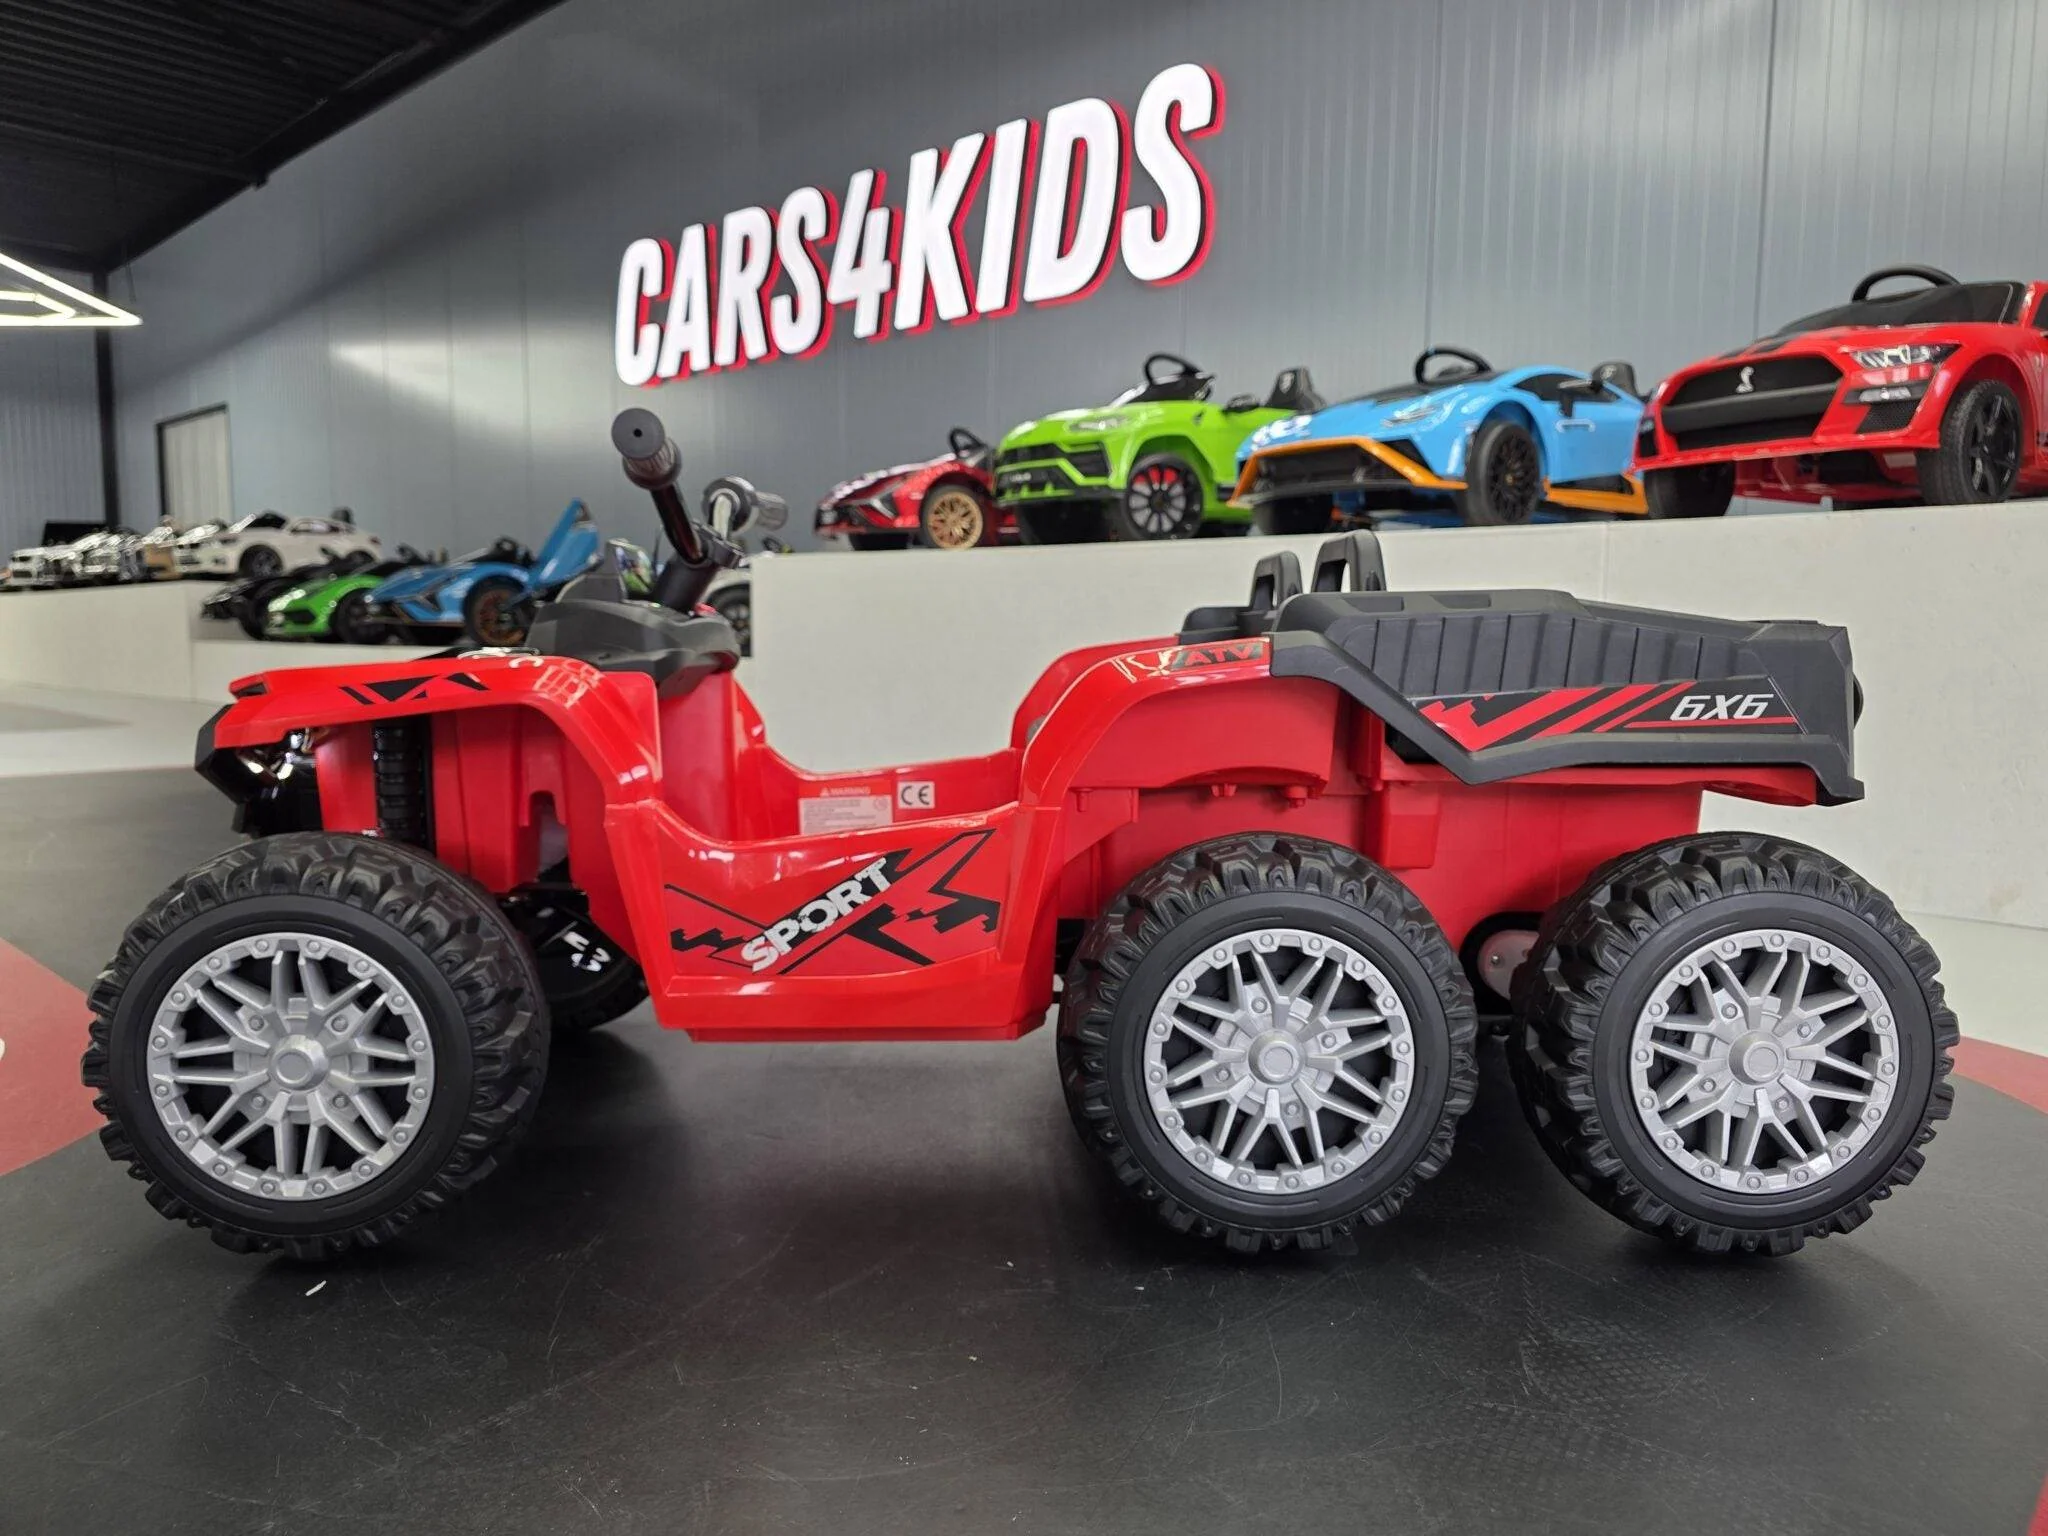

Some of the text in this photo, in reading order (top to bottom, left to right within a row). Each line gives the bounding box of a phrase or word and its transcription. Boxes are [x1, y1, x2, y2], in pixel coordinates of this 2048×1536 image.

[616, 64, 1224, 387] CARS4KIDS
[1184, 643, 1257, 666] ATV
[901, 785, 930, 806] CE
[741, 857, 892, 973] SPORT
